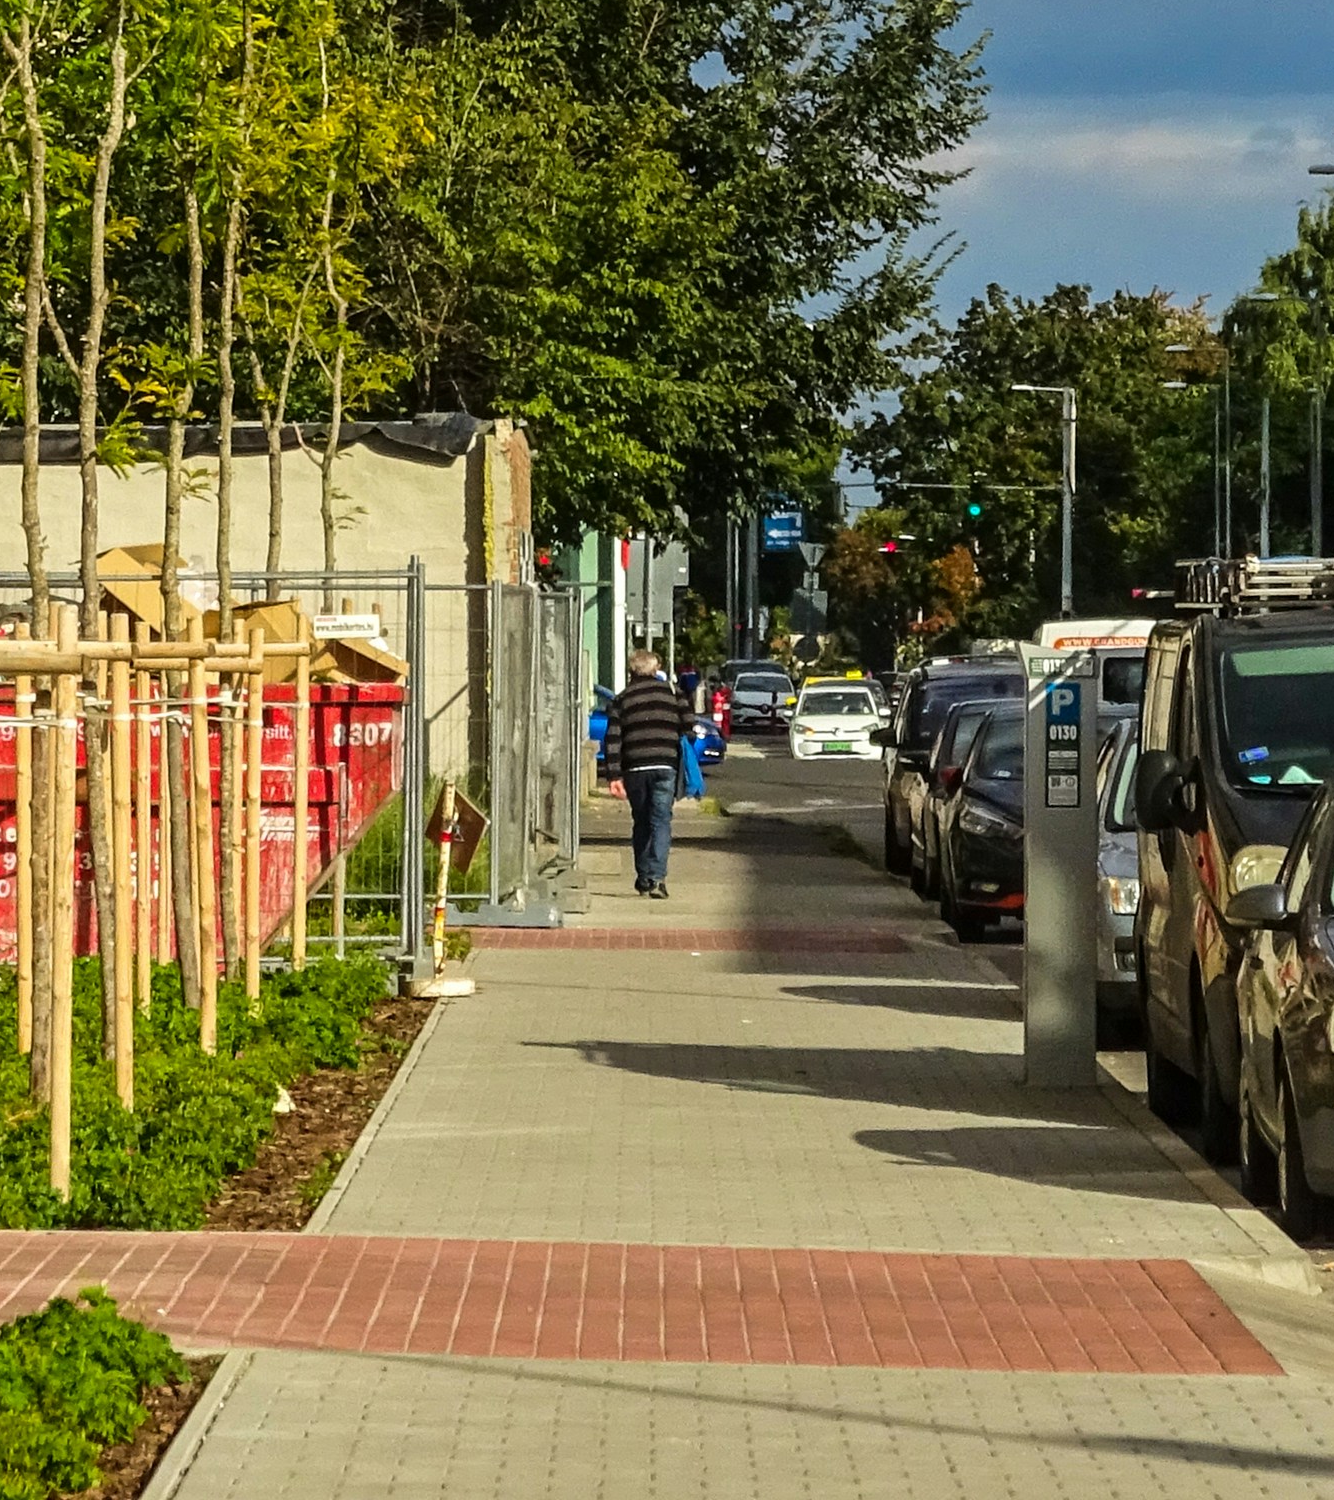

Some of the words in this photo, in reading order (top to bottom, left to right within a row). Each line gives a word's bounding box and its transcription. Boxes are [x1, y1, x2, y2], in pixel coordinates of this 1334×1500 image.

[1051, 689, 1075, 716] P
[333, 722, 393, 747] 8307
[1049, 725, 1077, 740] 0130
